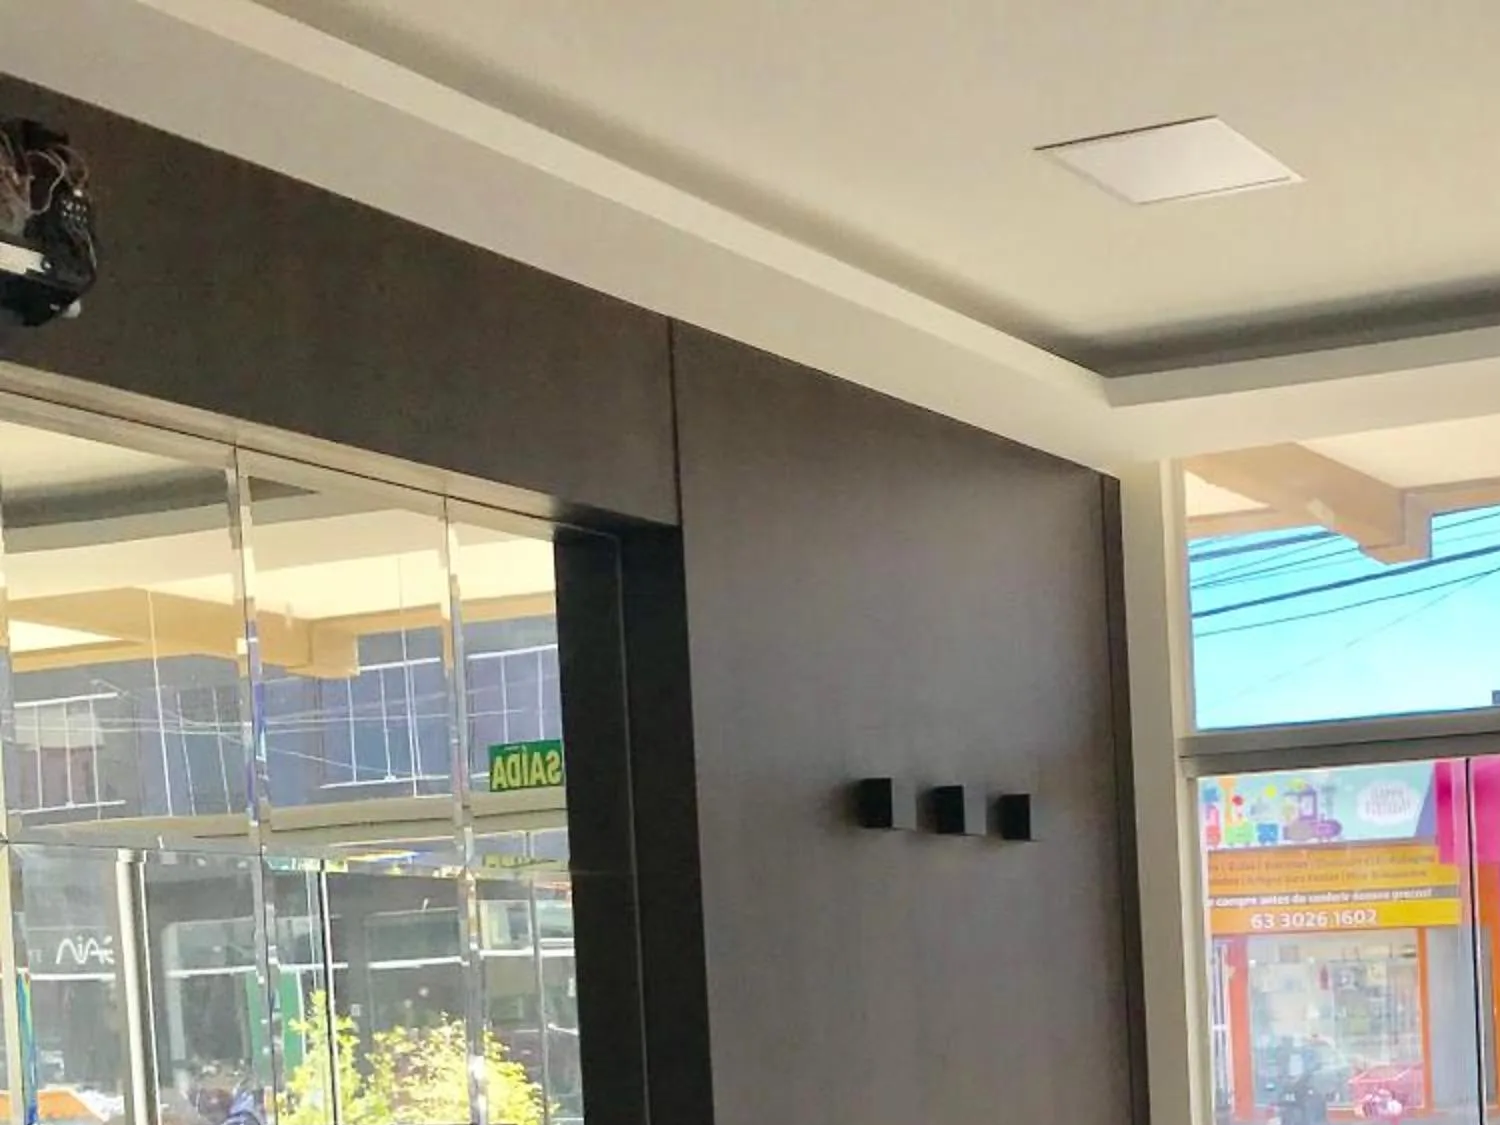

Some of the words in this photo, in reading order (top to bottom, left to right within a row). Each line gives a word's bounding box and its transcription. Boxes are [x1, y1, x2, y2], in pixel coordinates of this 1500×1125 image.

[1250, 912, 1275, 930] 63
[1279, 910, 1329, 929] 3026
[1334, 908, 1378, 927] 1602
